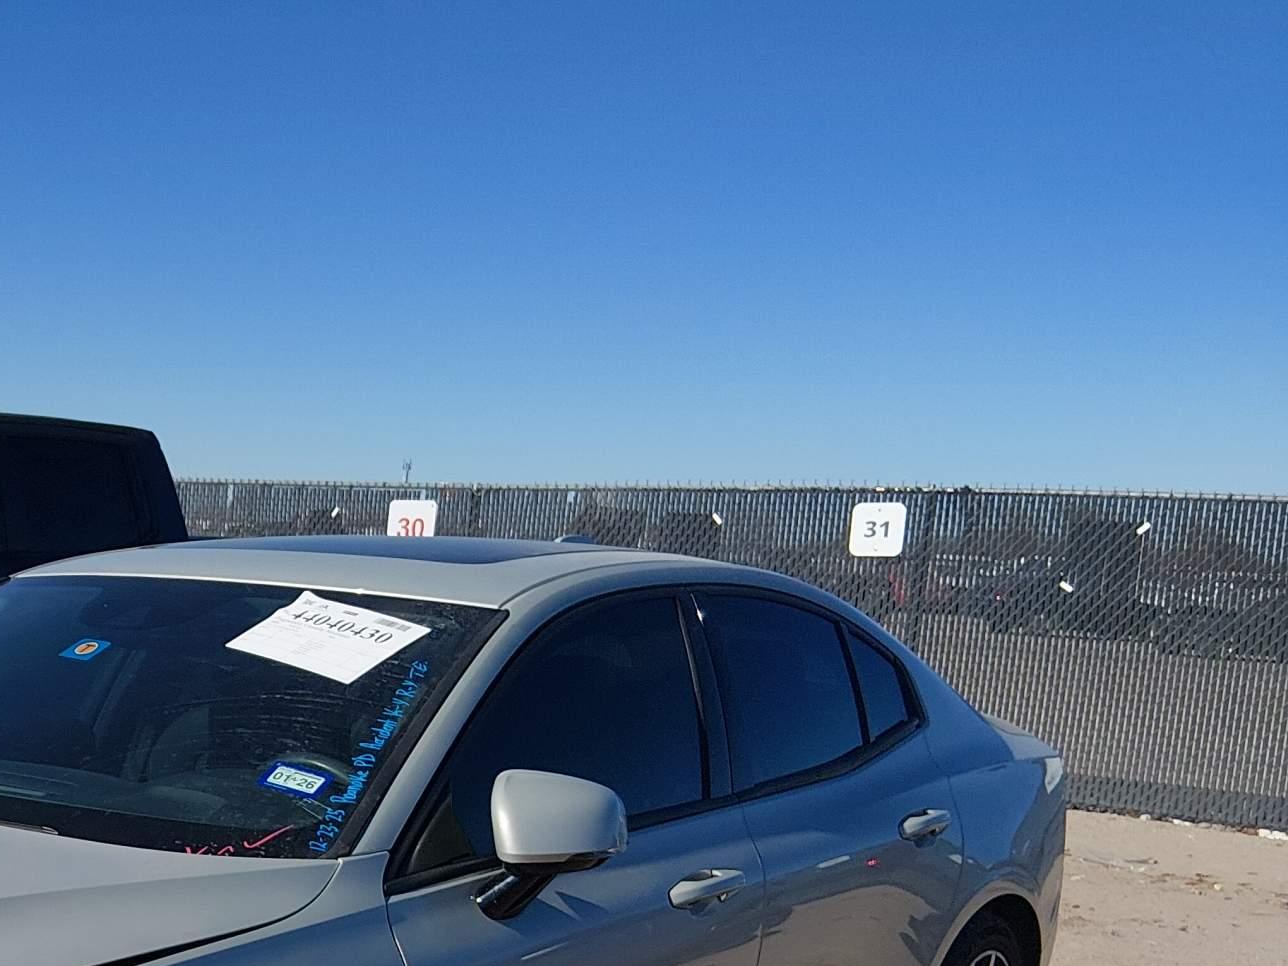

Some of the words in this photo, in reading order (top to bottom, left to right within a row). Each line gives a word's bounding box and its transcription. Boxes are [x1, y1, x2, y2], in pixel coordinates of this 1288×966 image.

[398, 518, 424, 537] 30
[863, 520, 890, 538] 31
[291, 609, 394, 644] 44040430
[351, 753, 376, 768] PD
